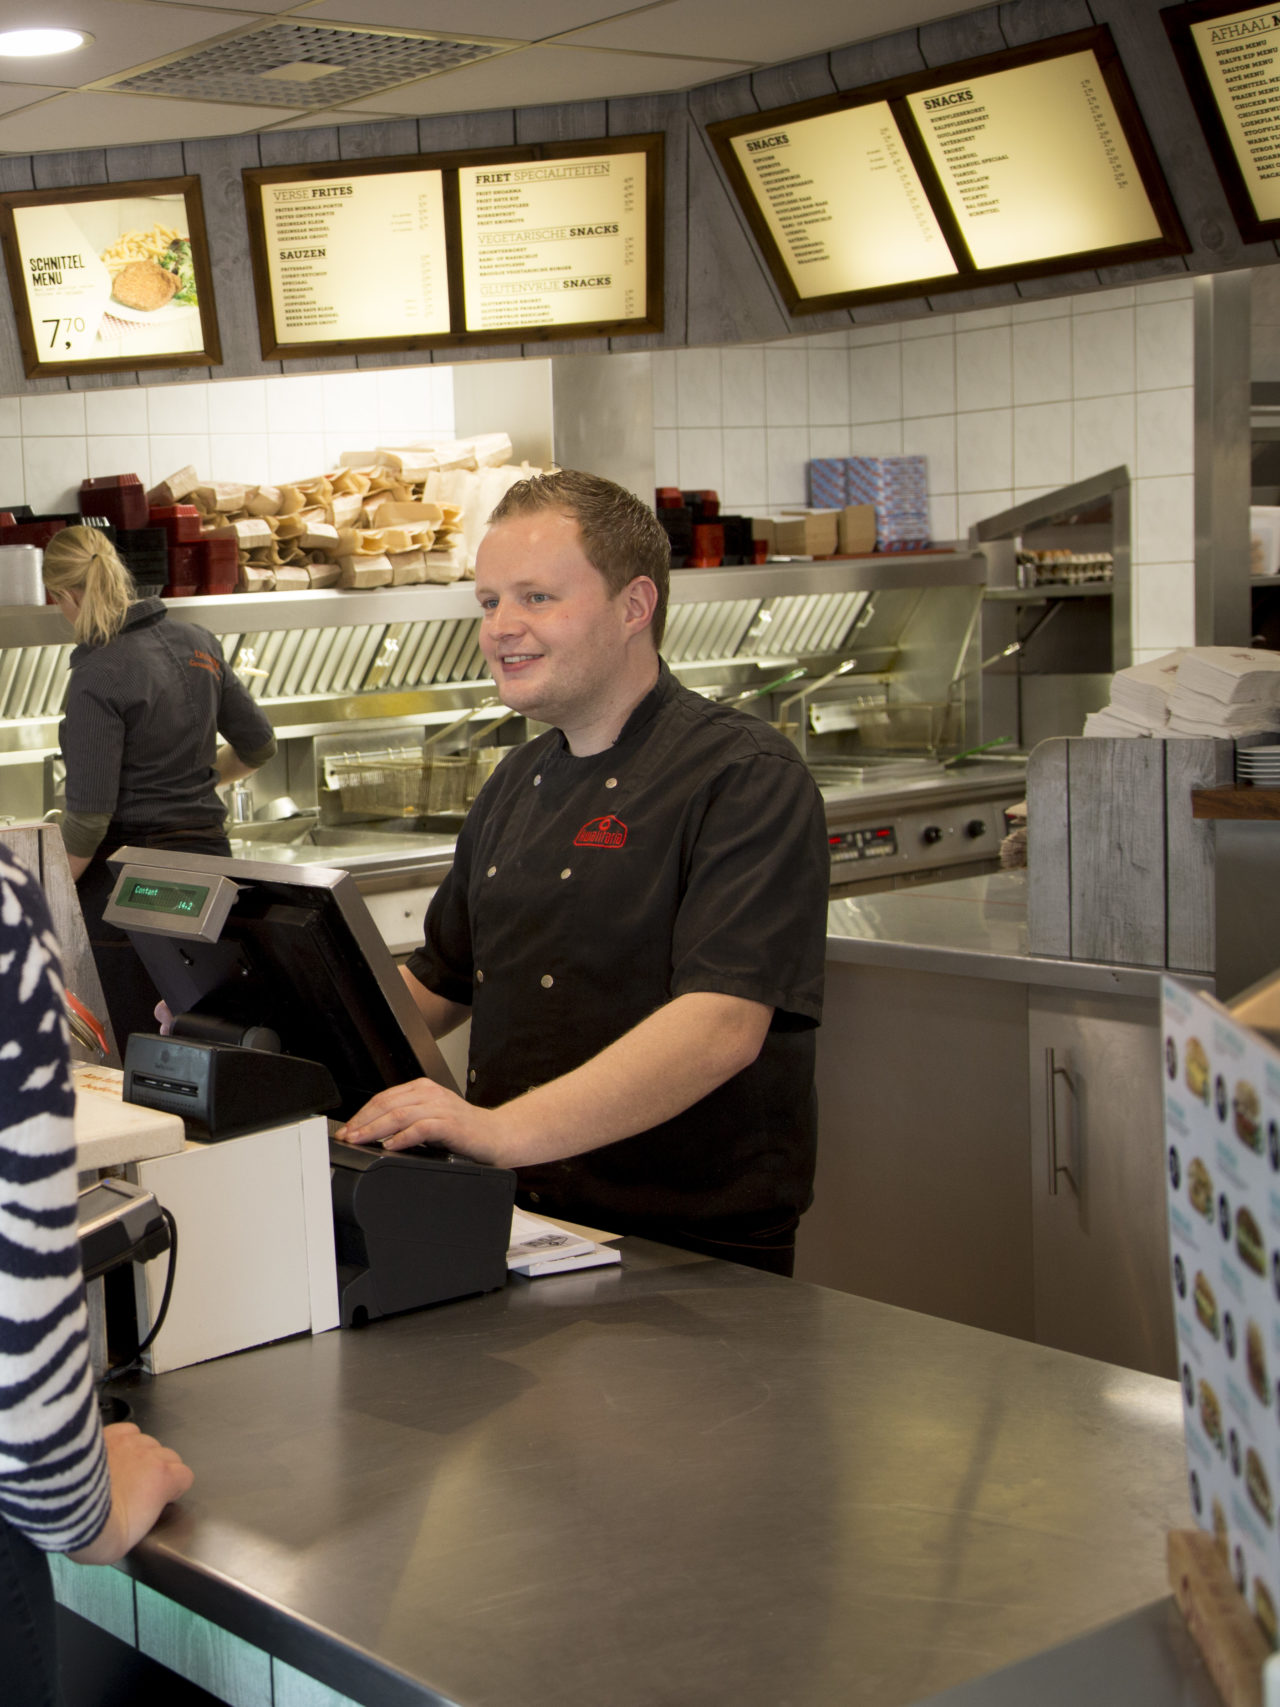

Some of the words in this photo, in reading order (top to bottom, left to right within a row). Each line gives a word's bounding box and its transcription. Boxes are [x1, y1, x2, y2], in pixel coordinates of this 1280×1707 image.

[1211, 18, 1271, 42] AFHAAL
[923, 90, 974, 110] SNACKS
[746, 134, 790, 152] SNACKS
[475, 172, 511, 185] FRIET
[513, 163, 610, 182] SPECIALITEITEN
[273, 190, 310, 201] VERSE
[311, 186, 353, 198] FRITES
[478, 228, 567, 245] VEGETARISCHE
[569, 224, 619, 237] SNACKS
[280, 248, 326, 260] SAUZEN
[29, 254, 86, 273] SCHNITZEL
[32, 271, 63, 288] MENU
[563, 276, 612, 289] SNACKS
[41, 316, 87, 350] 7,70
[134, 885, 159, 896] Contant
